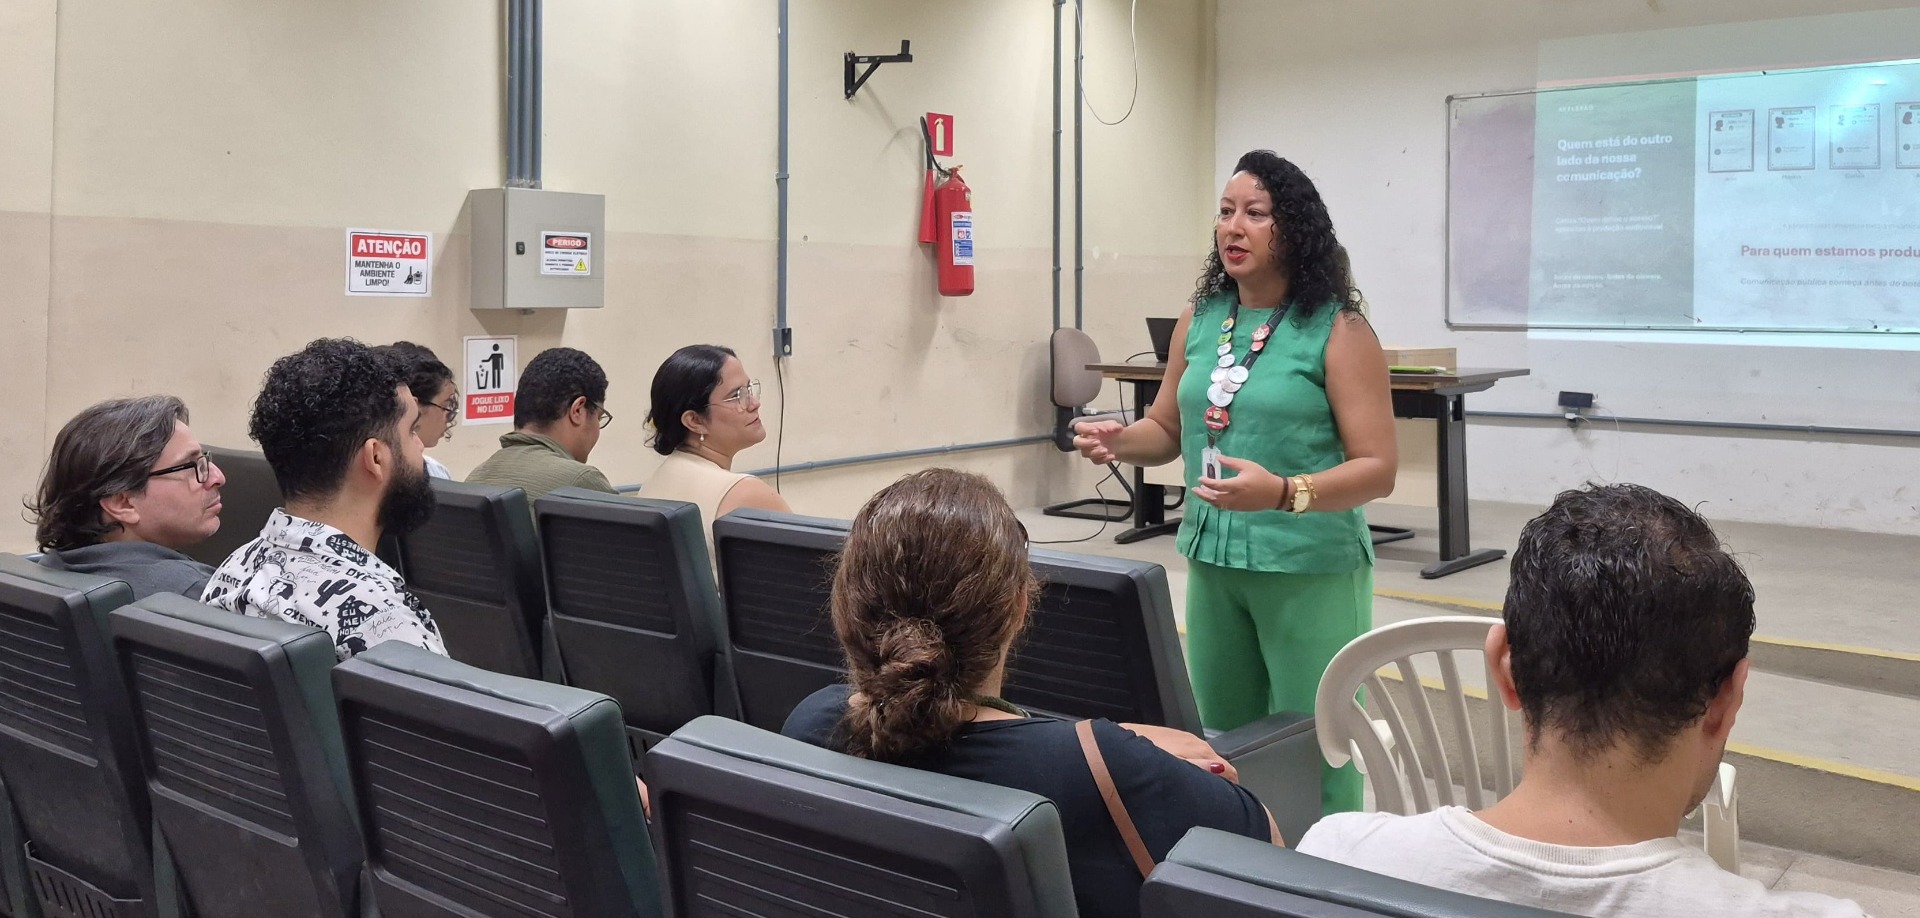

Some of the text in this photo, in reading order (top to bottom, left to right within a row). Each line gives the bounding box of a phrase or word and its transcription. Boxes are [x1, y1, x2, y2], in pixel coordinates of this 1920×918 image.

[1557, 134, 1673, 151] Quem está do outro
[1556, 154, 1637, 166] lado da nossa
[1556, 167, 1642, 182] comunicação?
[357, 238, 421, 258] ATENÇÃO
[552, 239, 582, 247] PERIGO
[1741, 245, 1770, 257] Para
[1773, 247, 1811, 258] quem
[1815, 246, 1876, 257] estamos
[354, 260, 401, 270] MANTENHA O
[360, 269, 395, 278] AMBIENTE
[365, 279, 390, 287] LIMPO!
[472, 395, 510, 405] JOGUE LIXO
[477, 404, 504, 413] NO LIXO
[342, 608, 356, 617] EU
